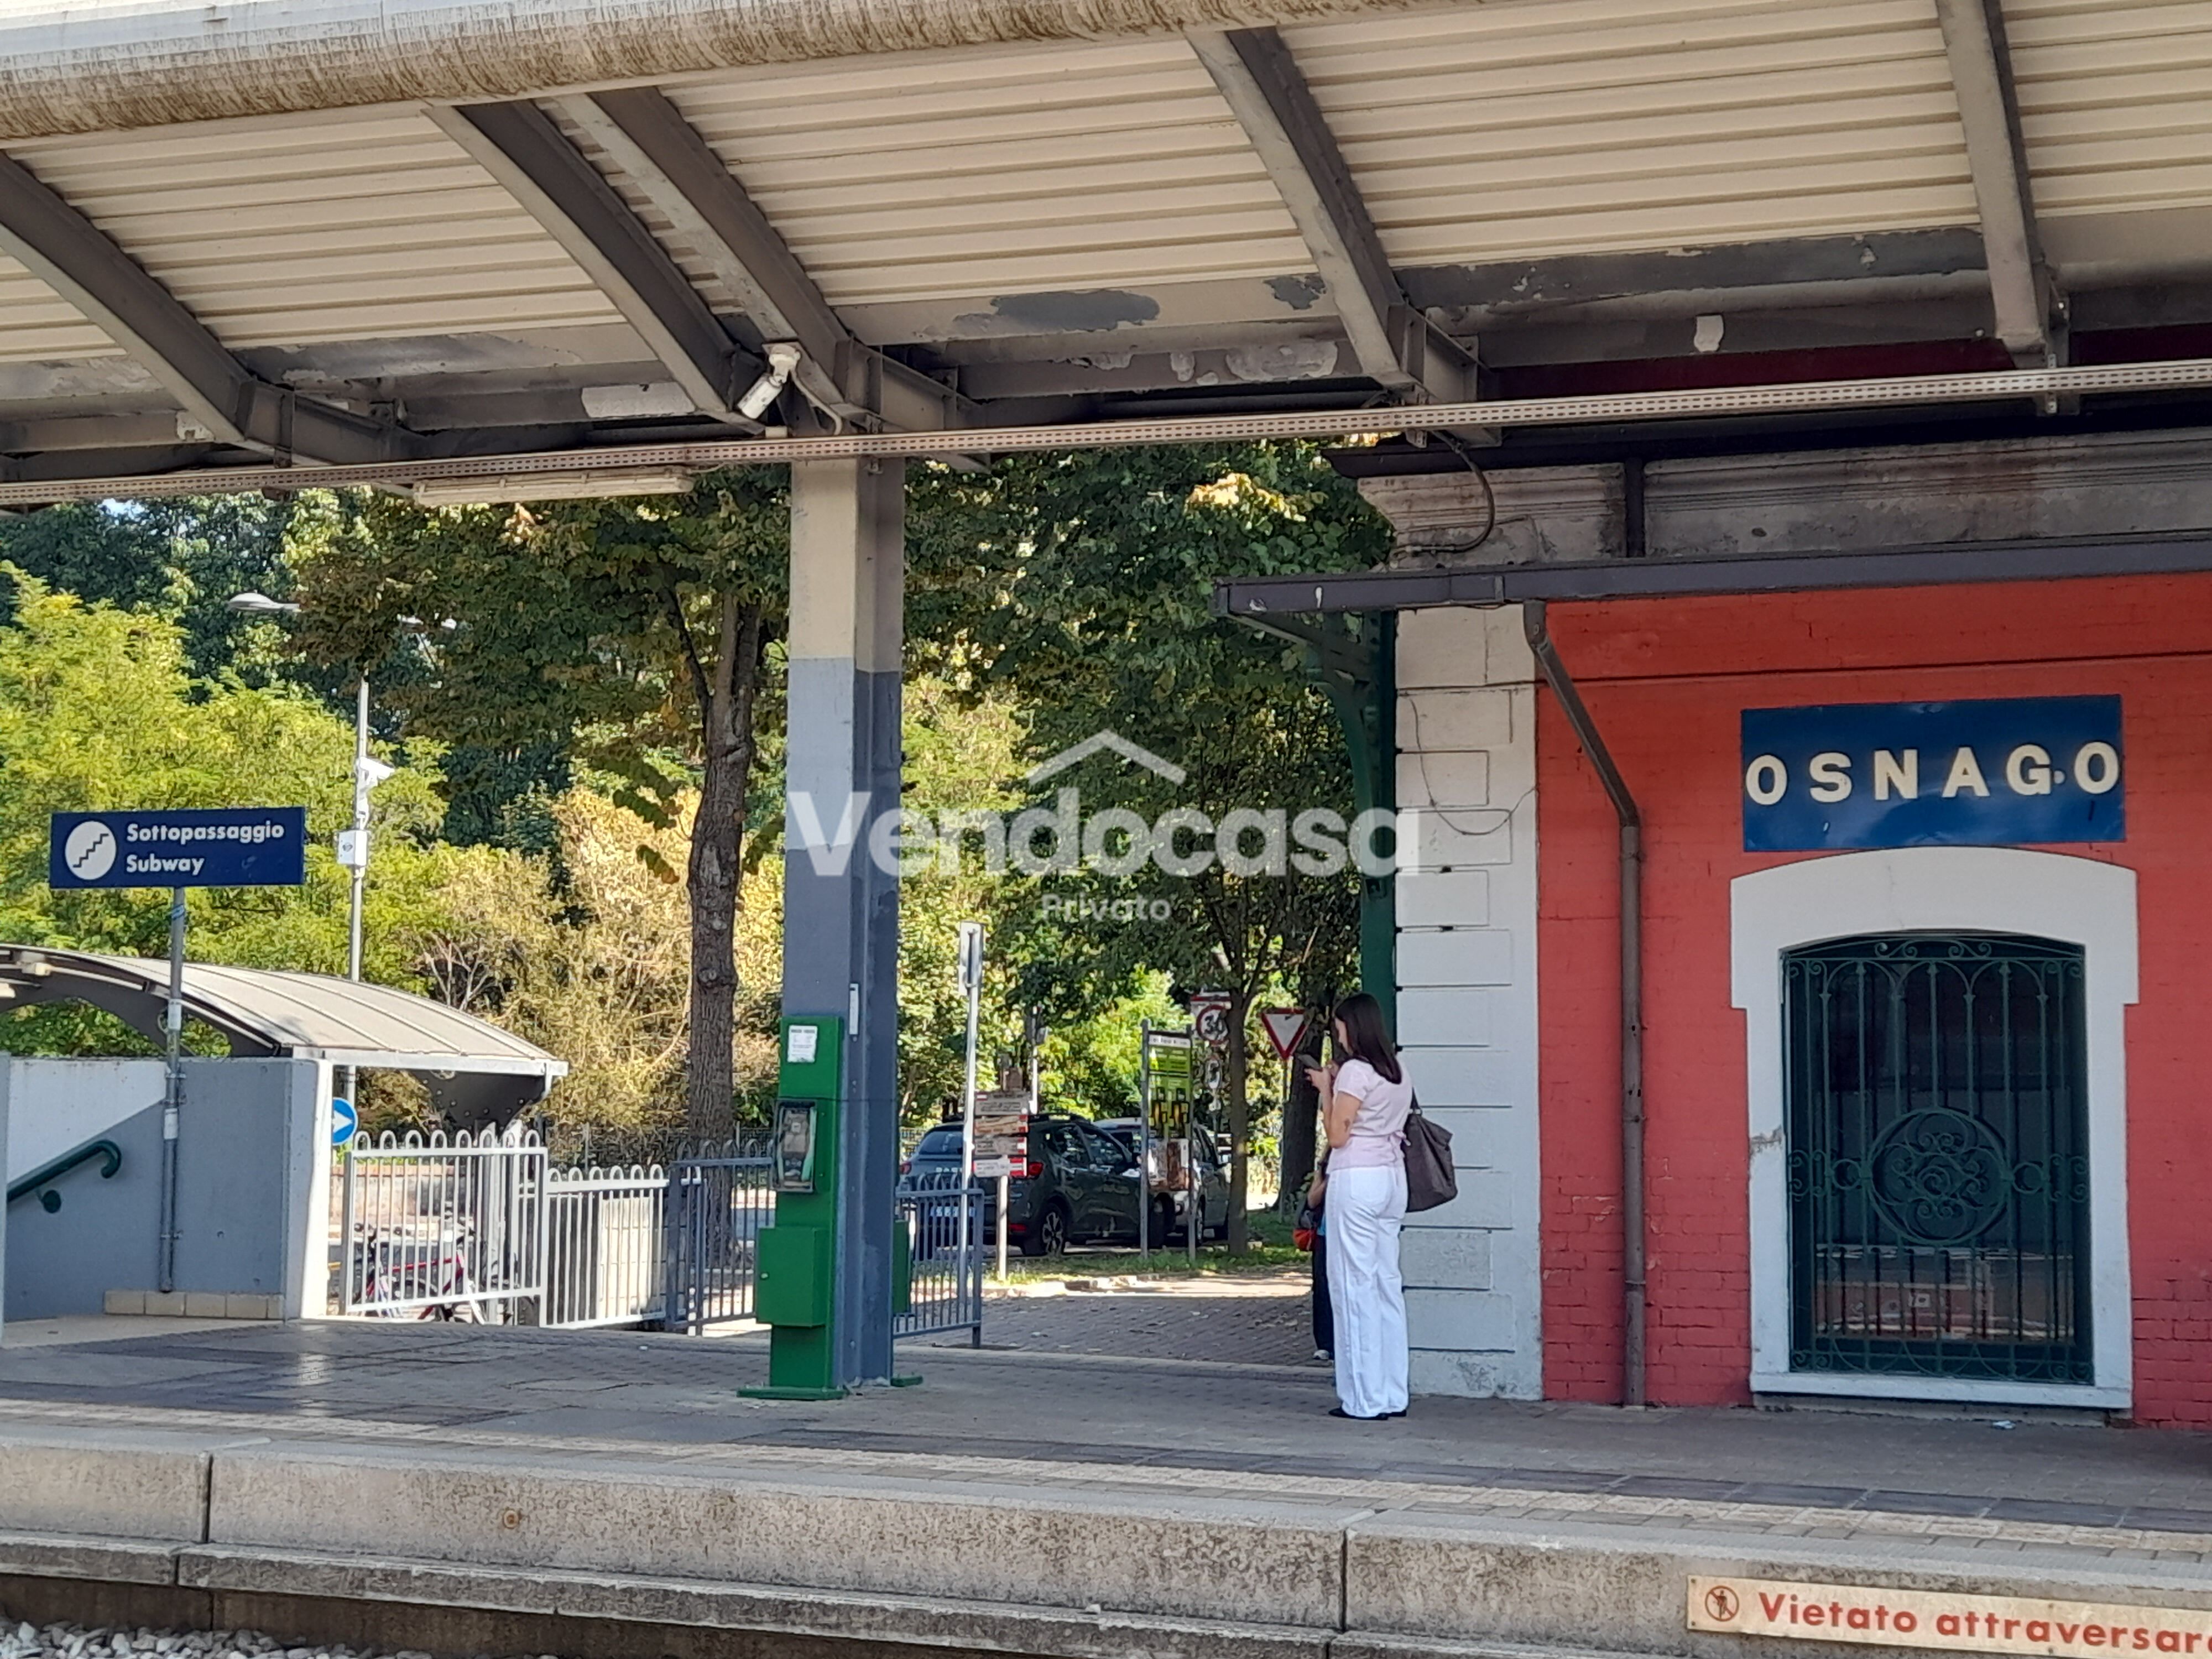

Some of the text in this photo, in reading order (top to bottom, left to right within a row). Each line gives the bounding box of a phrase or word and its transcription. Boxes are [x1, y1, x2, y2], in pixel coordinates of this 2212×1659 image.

[1745, 742, 2119, 806] OSNAGO
[127, 820, 285, 845] Sottopassaggio
[126, 853, 205, 876] Subway
[1760, 1593, 2212, 1653] Vietato attraversar
